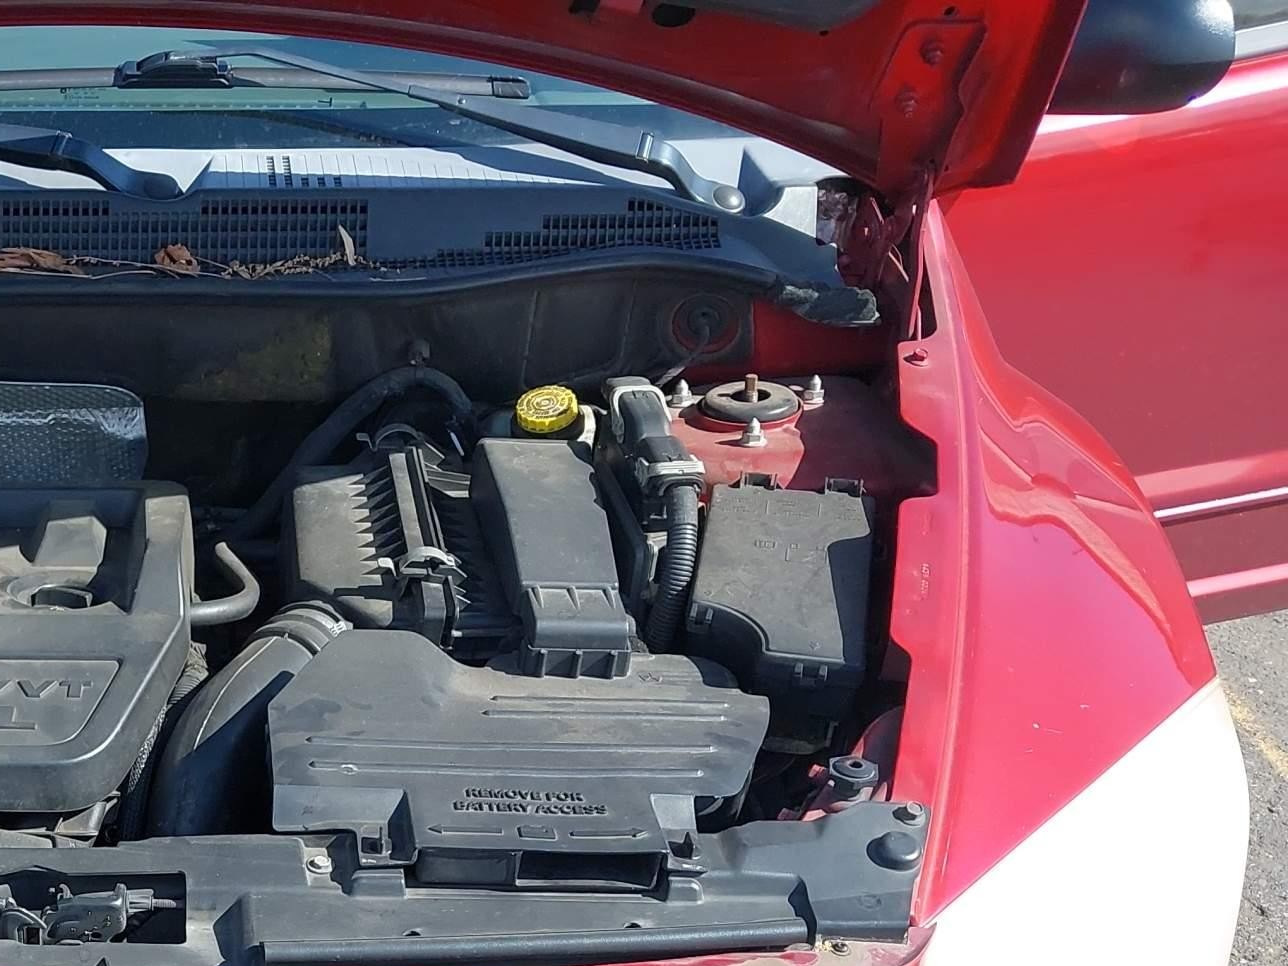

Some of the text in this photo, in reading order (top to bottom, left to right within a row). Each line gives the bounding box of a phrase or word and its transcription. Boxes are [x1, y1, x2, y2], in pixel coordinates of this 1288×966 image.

[464, 787, 585, 803] REMOVE FOR
[452, 800, 608, 816] BATTERY ACCESS
